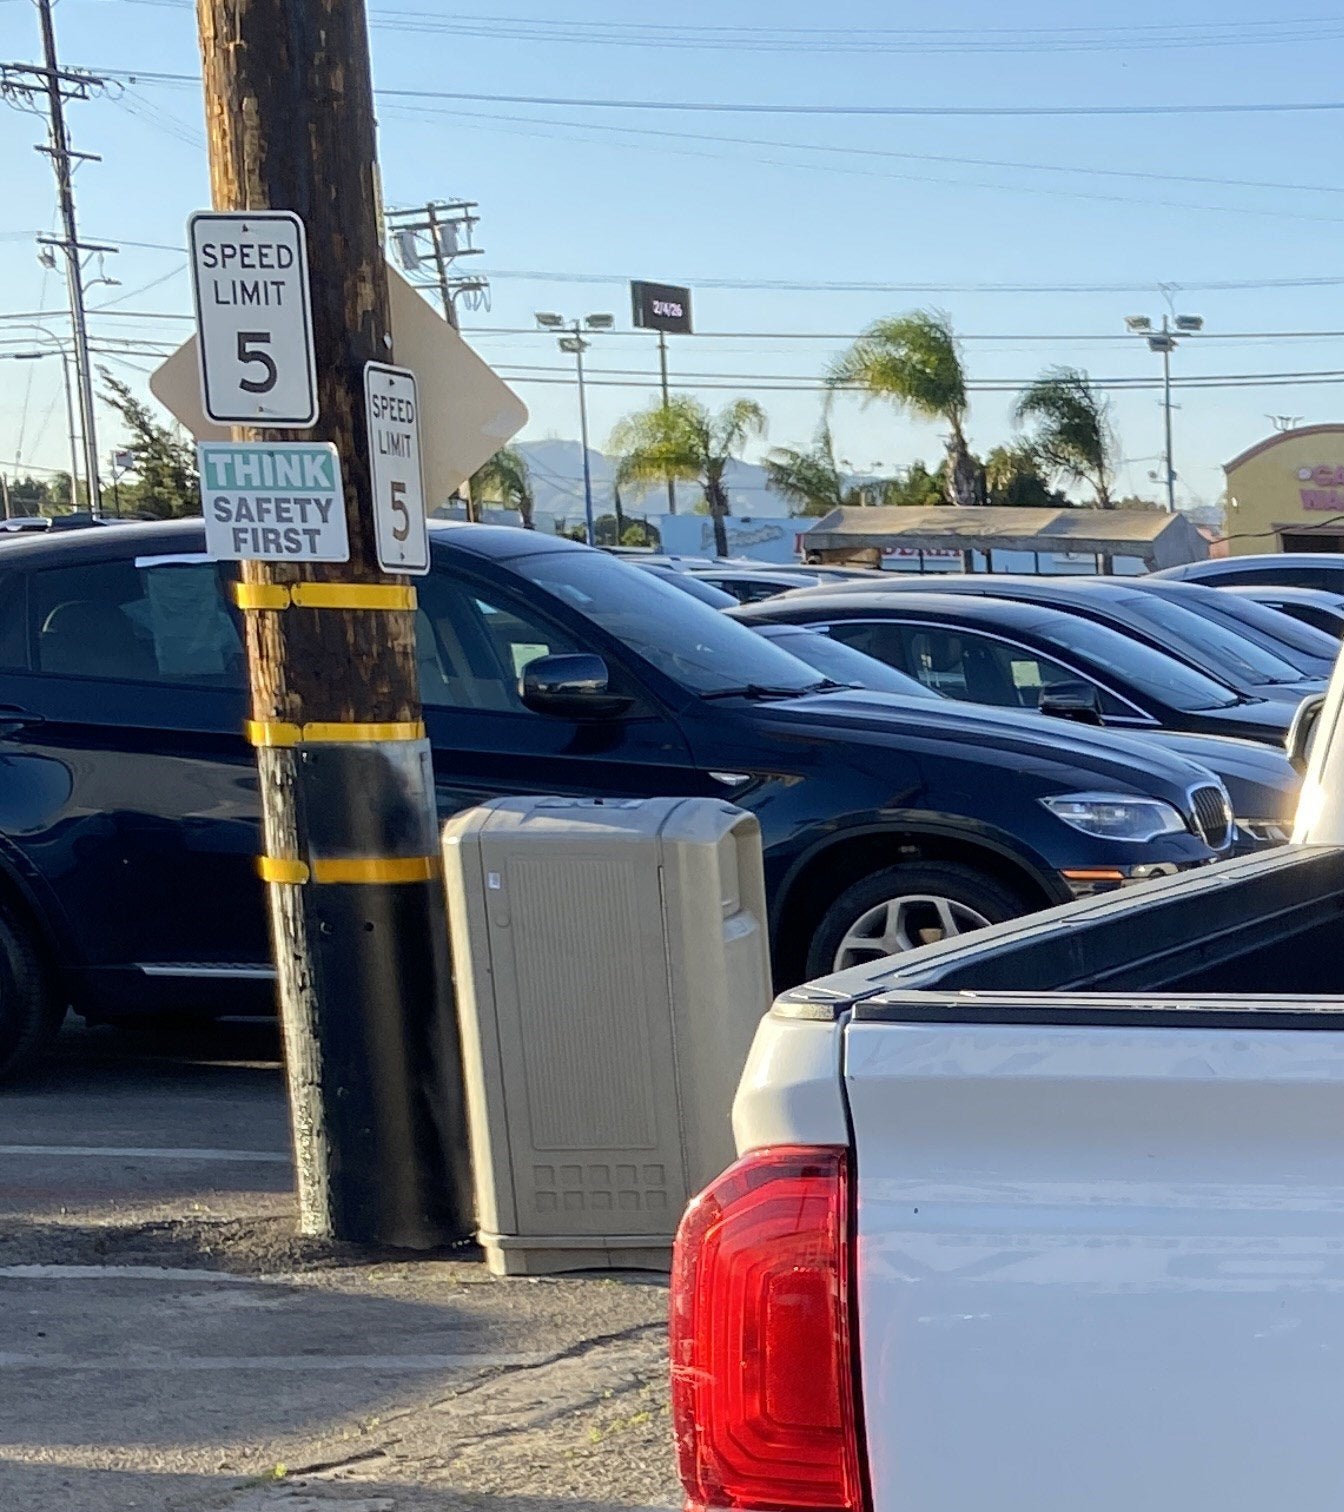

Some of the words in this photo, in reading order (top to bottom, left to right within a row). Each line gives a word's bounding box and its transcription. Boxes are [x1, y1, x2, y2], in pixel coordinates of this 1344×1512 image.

[202, 243, 294, 269] SPEED
[213, 280, 286, 306] LIMIT
[235, 331, 279, 394] 5
[371, 393, 415, 425] SPEED
[377, 432, 412, 459] LIMIT
[207, 453, 333, 488] THINK
[213, 495, 334, 525] SAFETY
[390, 480, 411, 542] 5
[231, 527, 321, 555] FIRST
